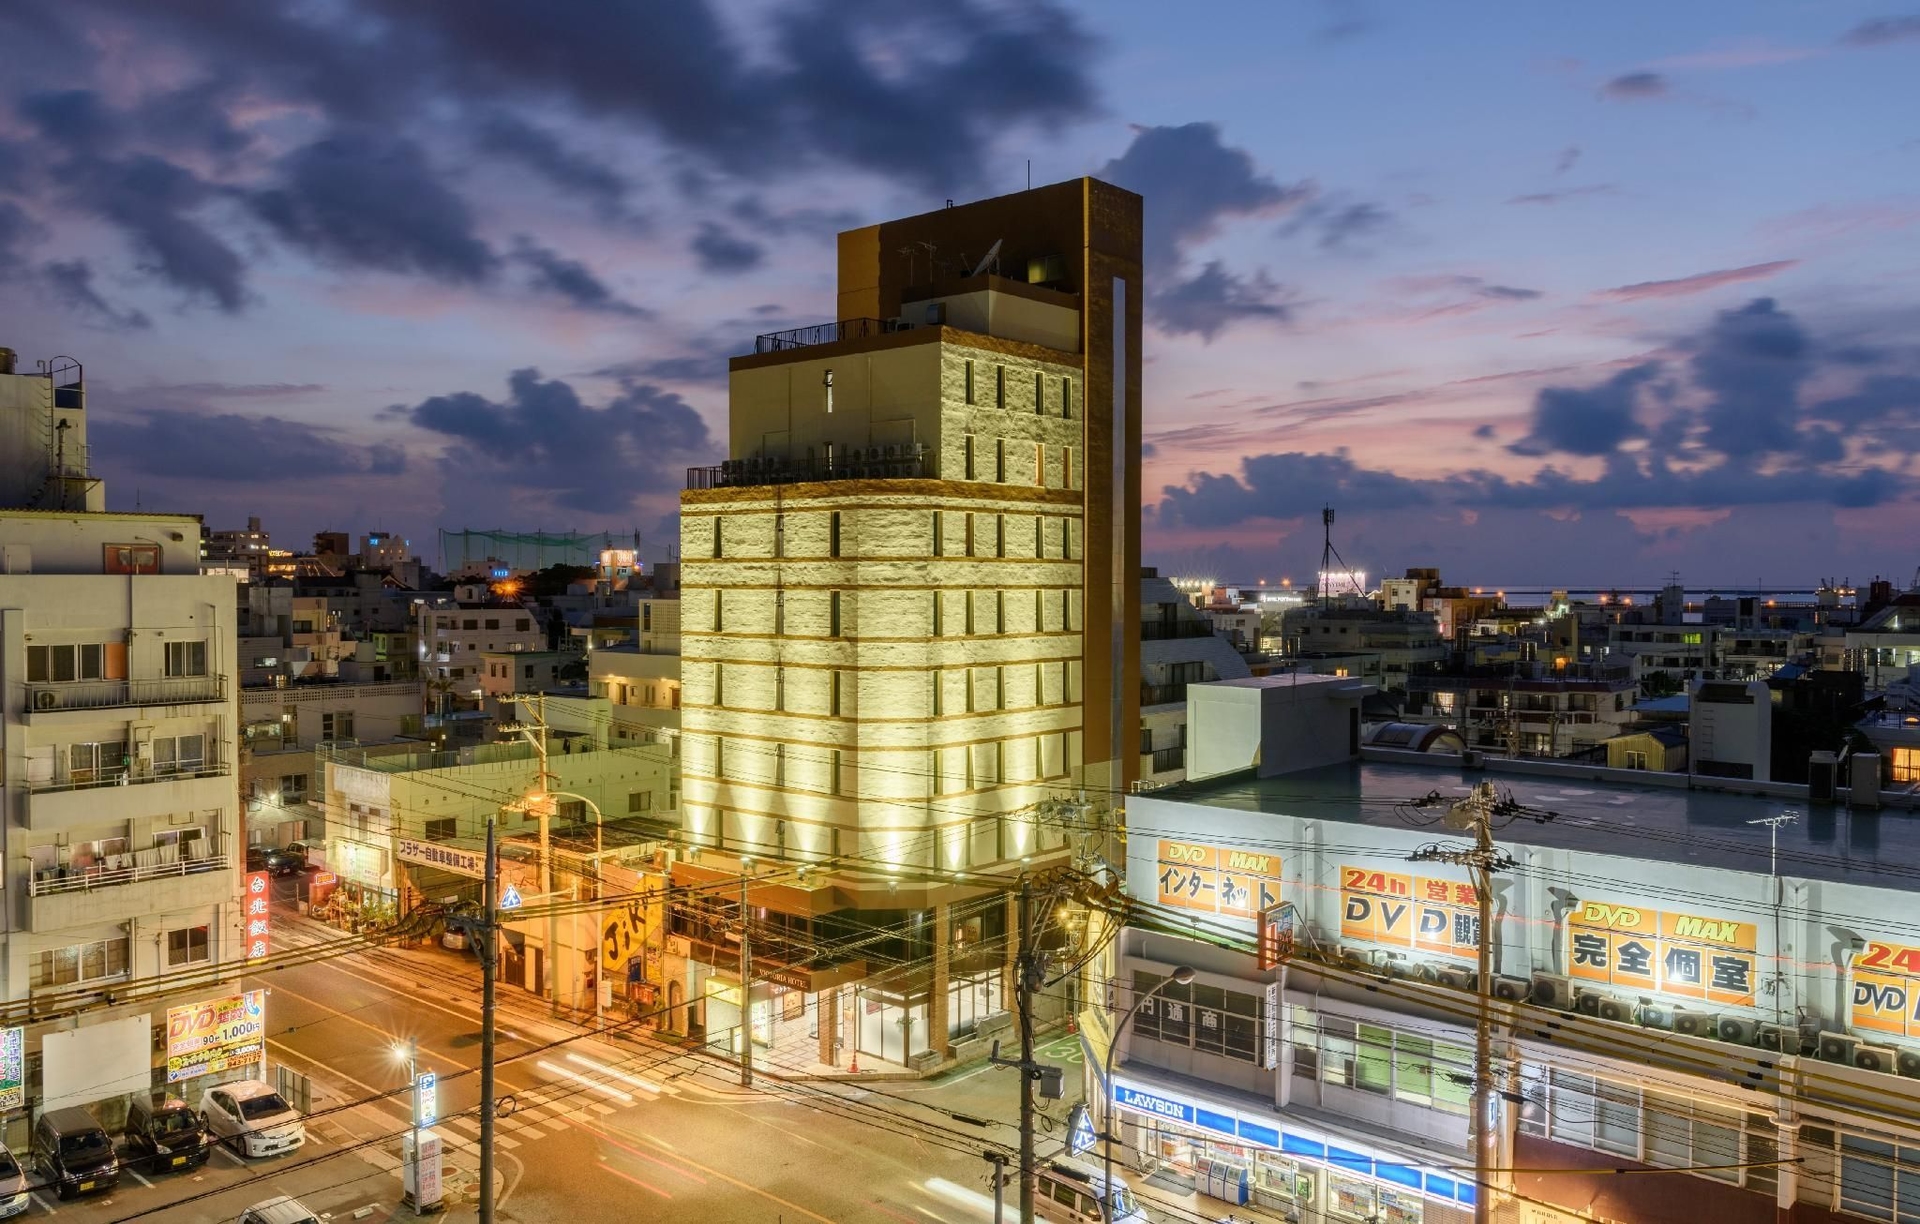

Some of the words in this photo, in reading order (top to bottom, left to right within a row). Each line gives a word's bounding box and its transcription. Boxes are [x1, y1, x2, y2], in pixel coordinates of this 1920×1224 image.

[1168, 843, 1207, 863] DVD
[1228, 851, 1270, 872] MAX
[1159, 867, 1276, 909] インターネット
[1346, 870, 1406, 895] 24h
[248, 876, 268, 959] 台北飯店
[1584, 904, 1641, 927] DVD
[1674, 916, 1739, 943] MAX
[1573, 934, 1750, 992] 完全個室
[169, 1008, 216, 1038] DVD
[1124, 1089, 1184, 1118] LAWSON
